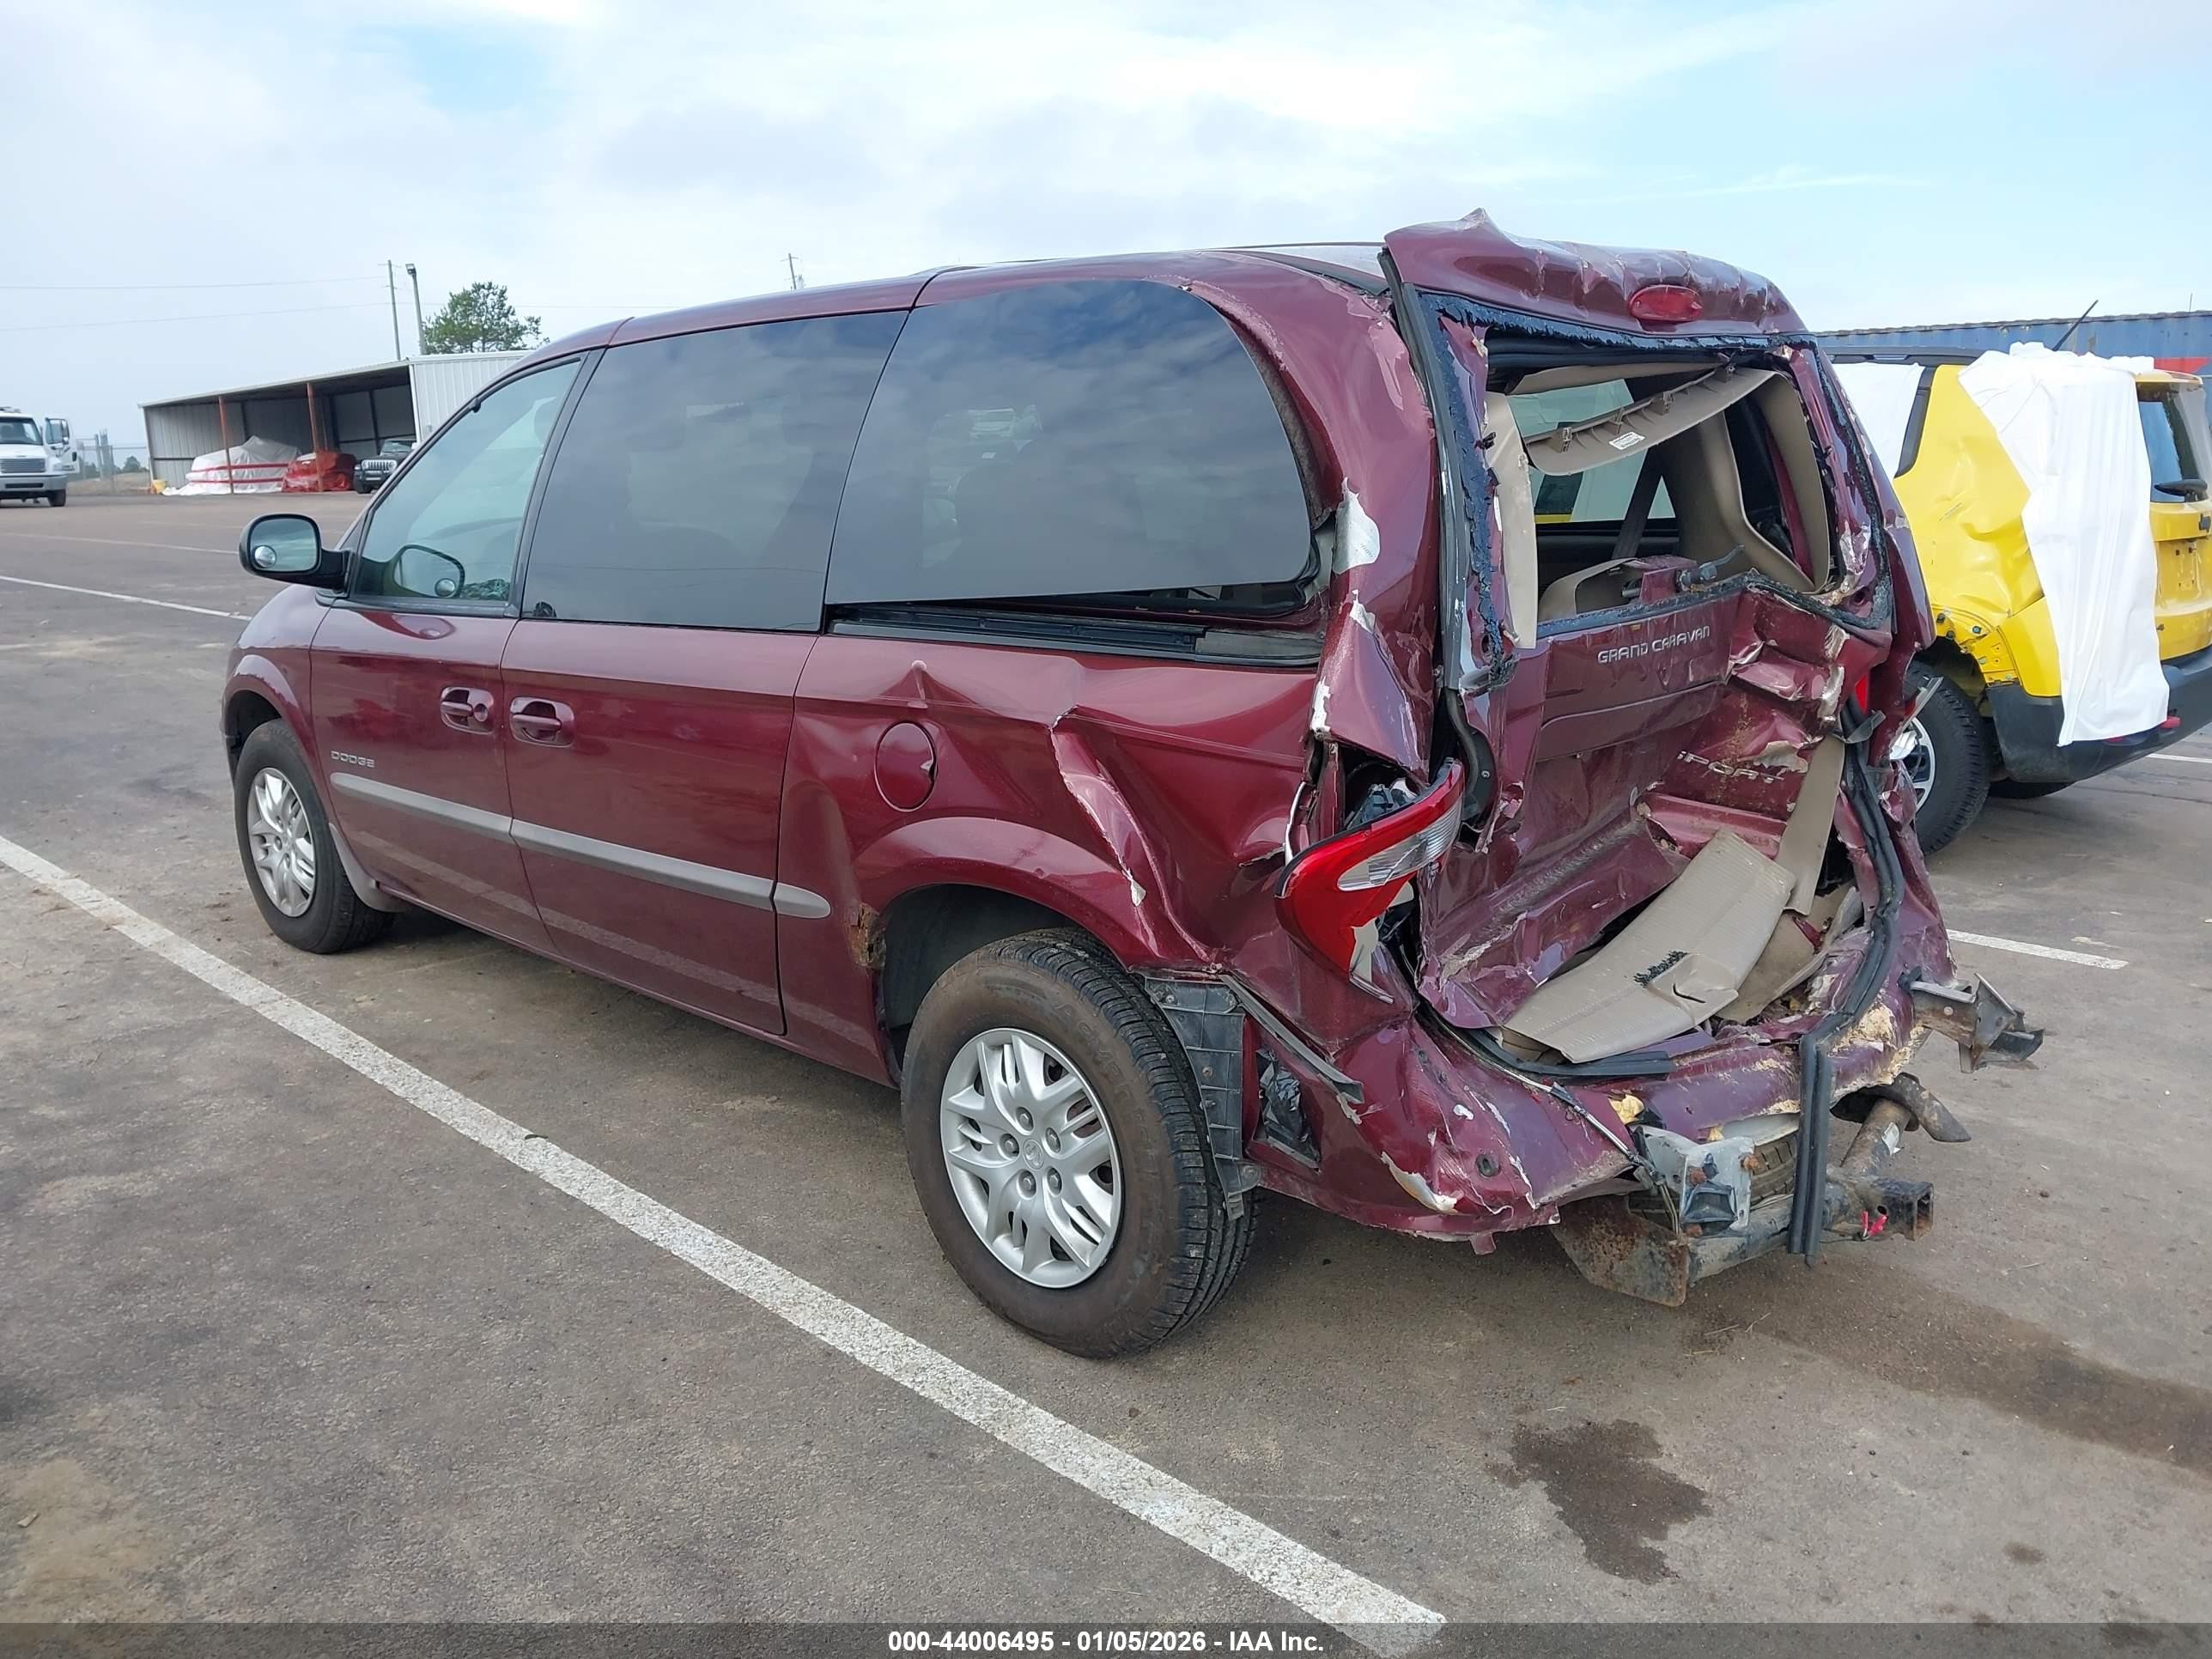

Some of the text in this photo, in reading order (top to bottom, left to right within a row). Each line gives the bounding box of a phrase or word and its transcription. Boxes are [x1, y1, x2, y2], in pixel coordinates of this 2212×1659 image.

[1597, 625, 1711, 665] GRAND CARAVAN
[330, 750, 375, 769] DODGE
